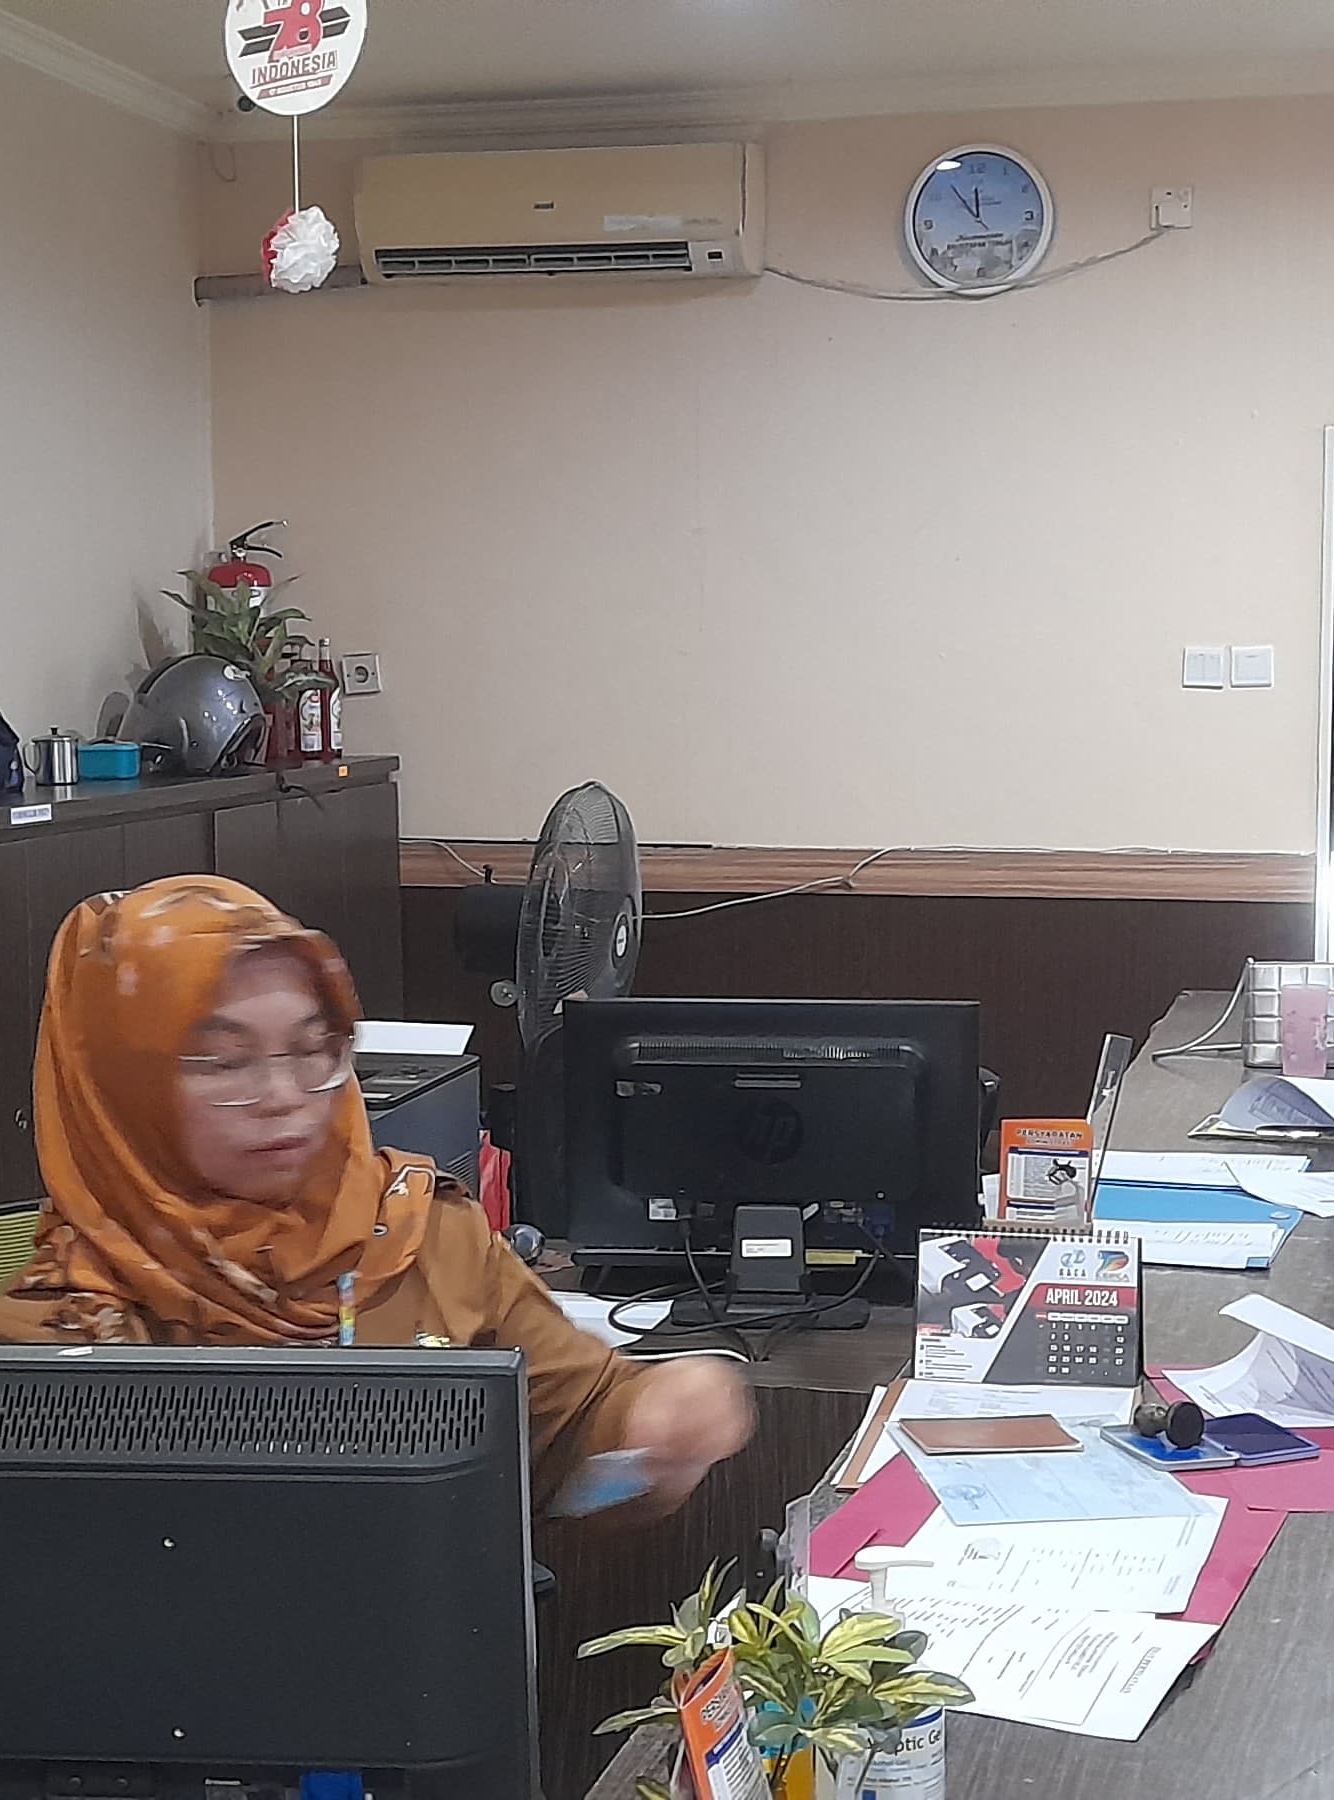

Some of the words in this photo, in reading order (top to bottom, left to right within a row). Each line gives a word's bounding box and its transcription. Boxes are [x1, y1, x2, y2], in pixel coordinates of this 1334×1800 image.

[251, 50, 337, 86] INDONESIA
[1046, 1288, 1082, 1305] APRIL
[1084, 1290, 1118, 1306] 2024
